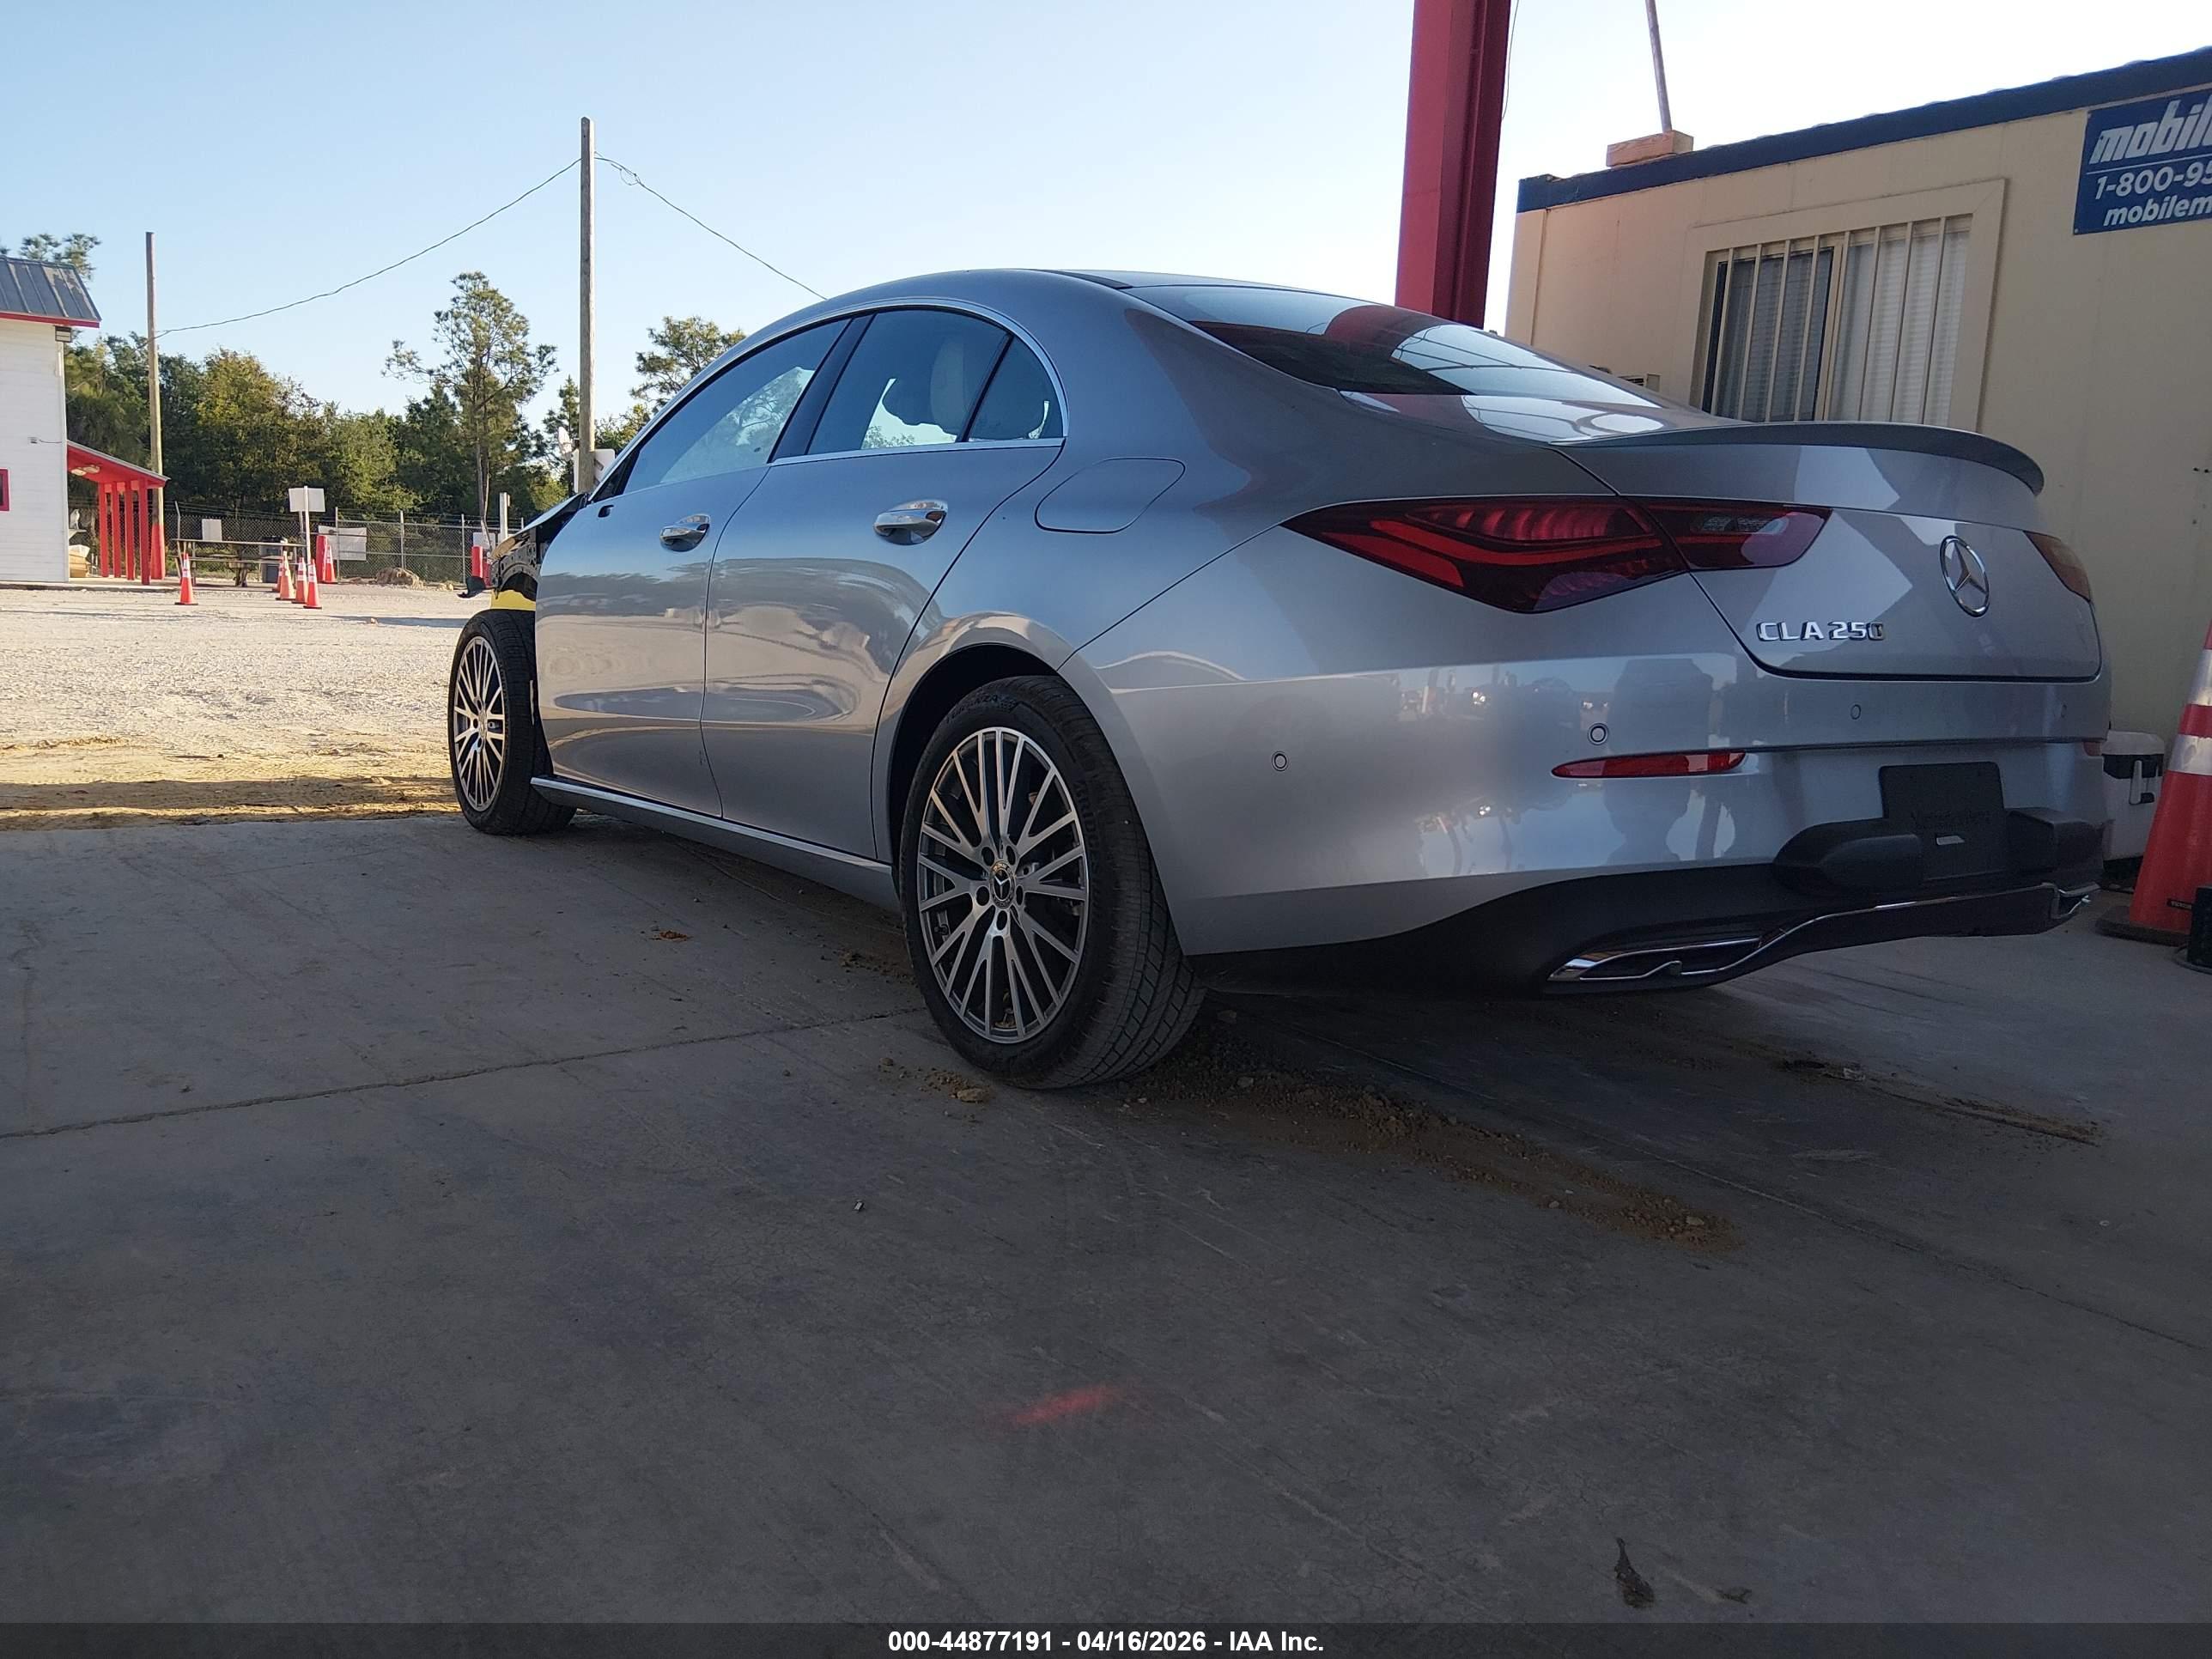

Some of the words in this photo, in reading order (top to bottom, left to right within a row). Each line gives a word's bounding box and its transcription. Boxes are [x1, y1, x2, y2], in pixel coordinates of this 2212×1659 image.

[2104, 195, 2212, 227] mobilem
[1757, 621, 1825, 641] CLA
[1828, 621, 1886, 641] 250
